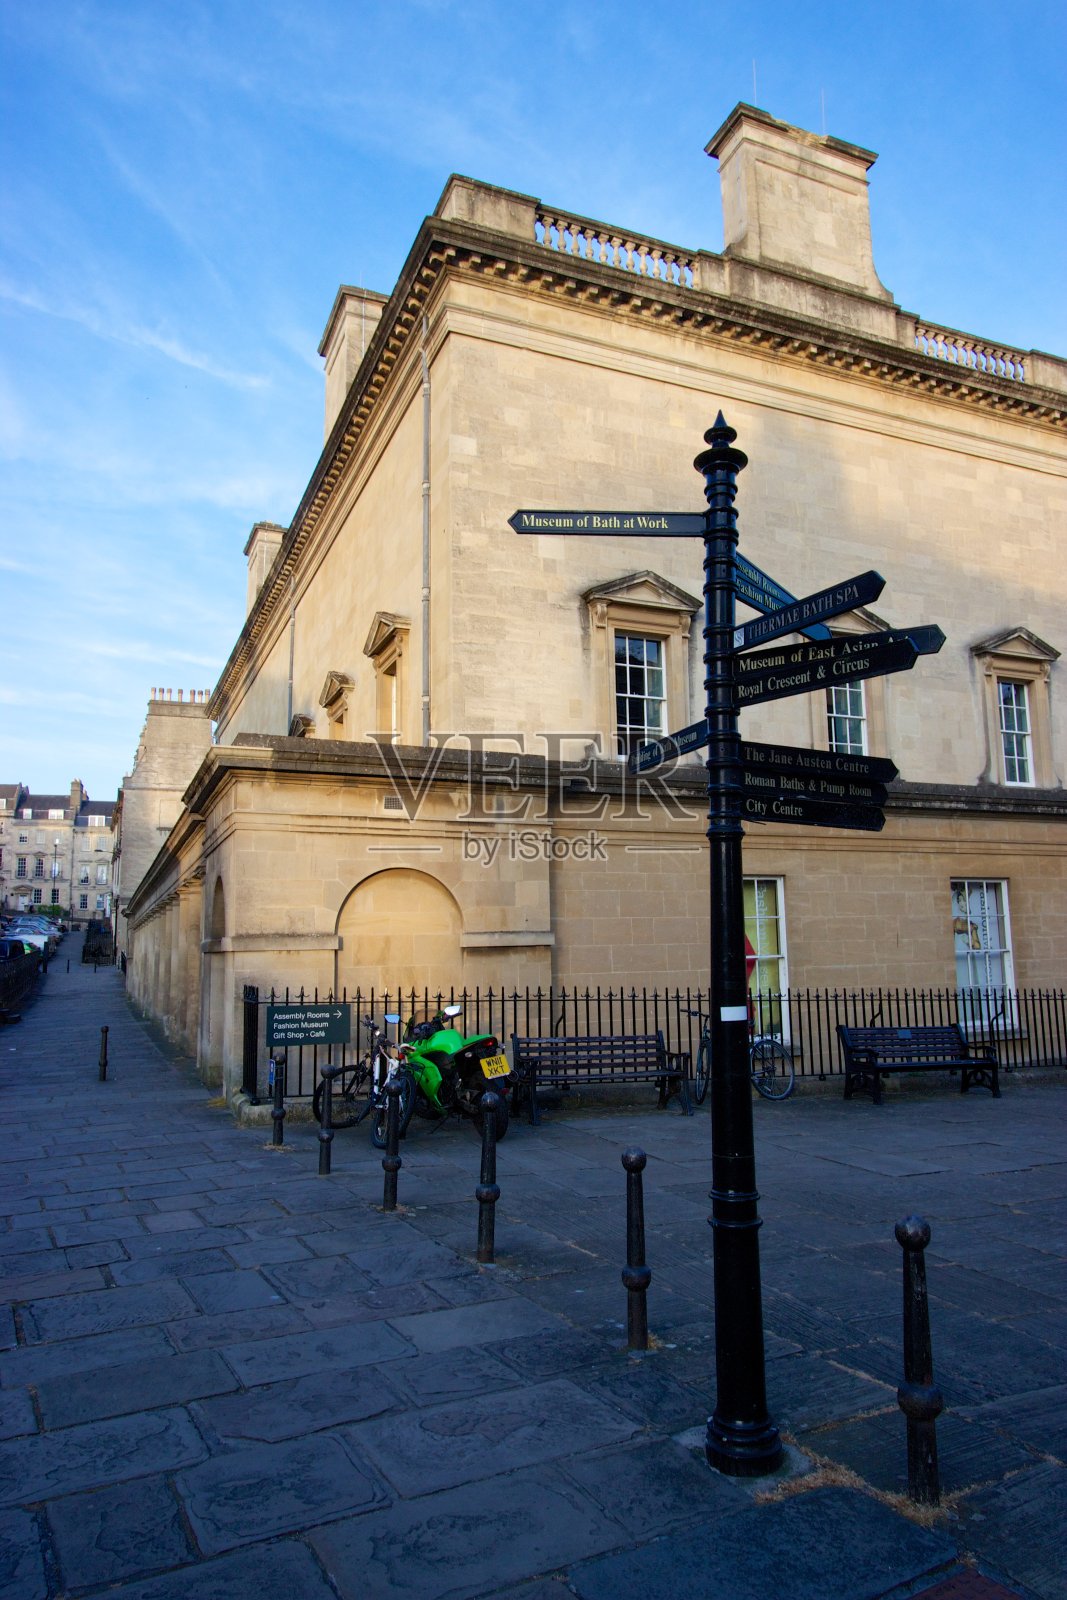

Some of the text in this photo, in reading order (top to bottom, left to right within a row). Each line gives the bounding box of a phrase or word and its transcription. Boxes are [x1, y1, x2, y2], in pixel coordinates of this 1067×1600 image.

[521, 514, 668, 529] Museum of Bath at Work
[736, 578, 782, 611] Fashion Mus
[749, 584, 859, 640] THERMAE BATH SPA
[739, 640, 879, 673] Museum of East Asian
[738, 658, 870, 699] Royal Crescent & Circus
[744, 746, 869, 774] The Jane Austen Centre
[744, 772, 872, 797] Roman Baths & Pump Room
[745, 798, 803, 816] City Centre
[273, 1012, 306, 1020] Assembly
[300, 1021, 329, 1029] Museum
[286, 1031, 305, 1040] Shop
[309, 1030, 326, 1038] Café
[487, 1066, 506, 1077] XKT
